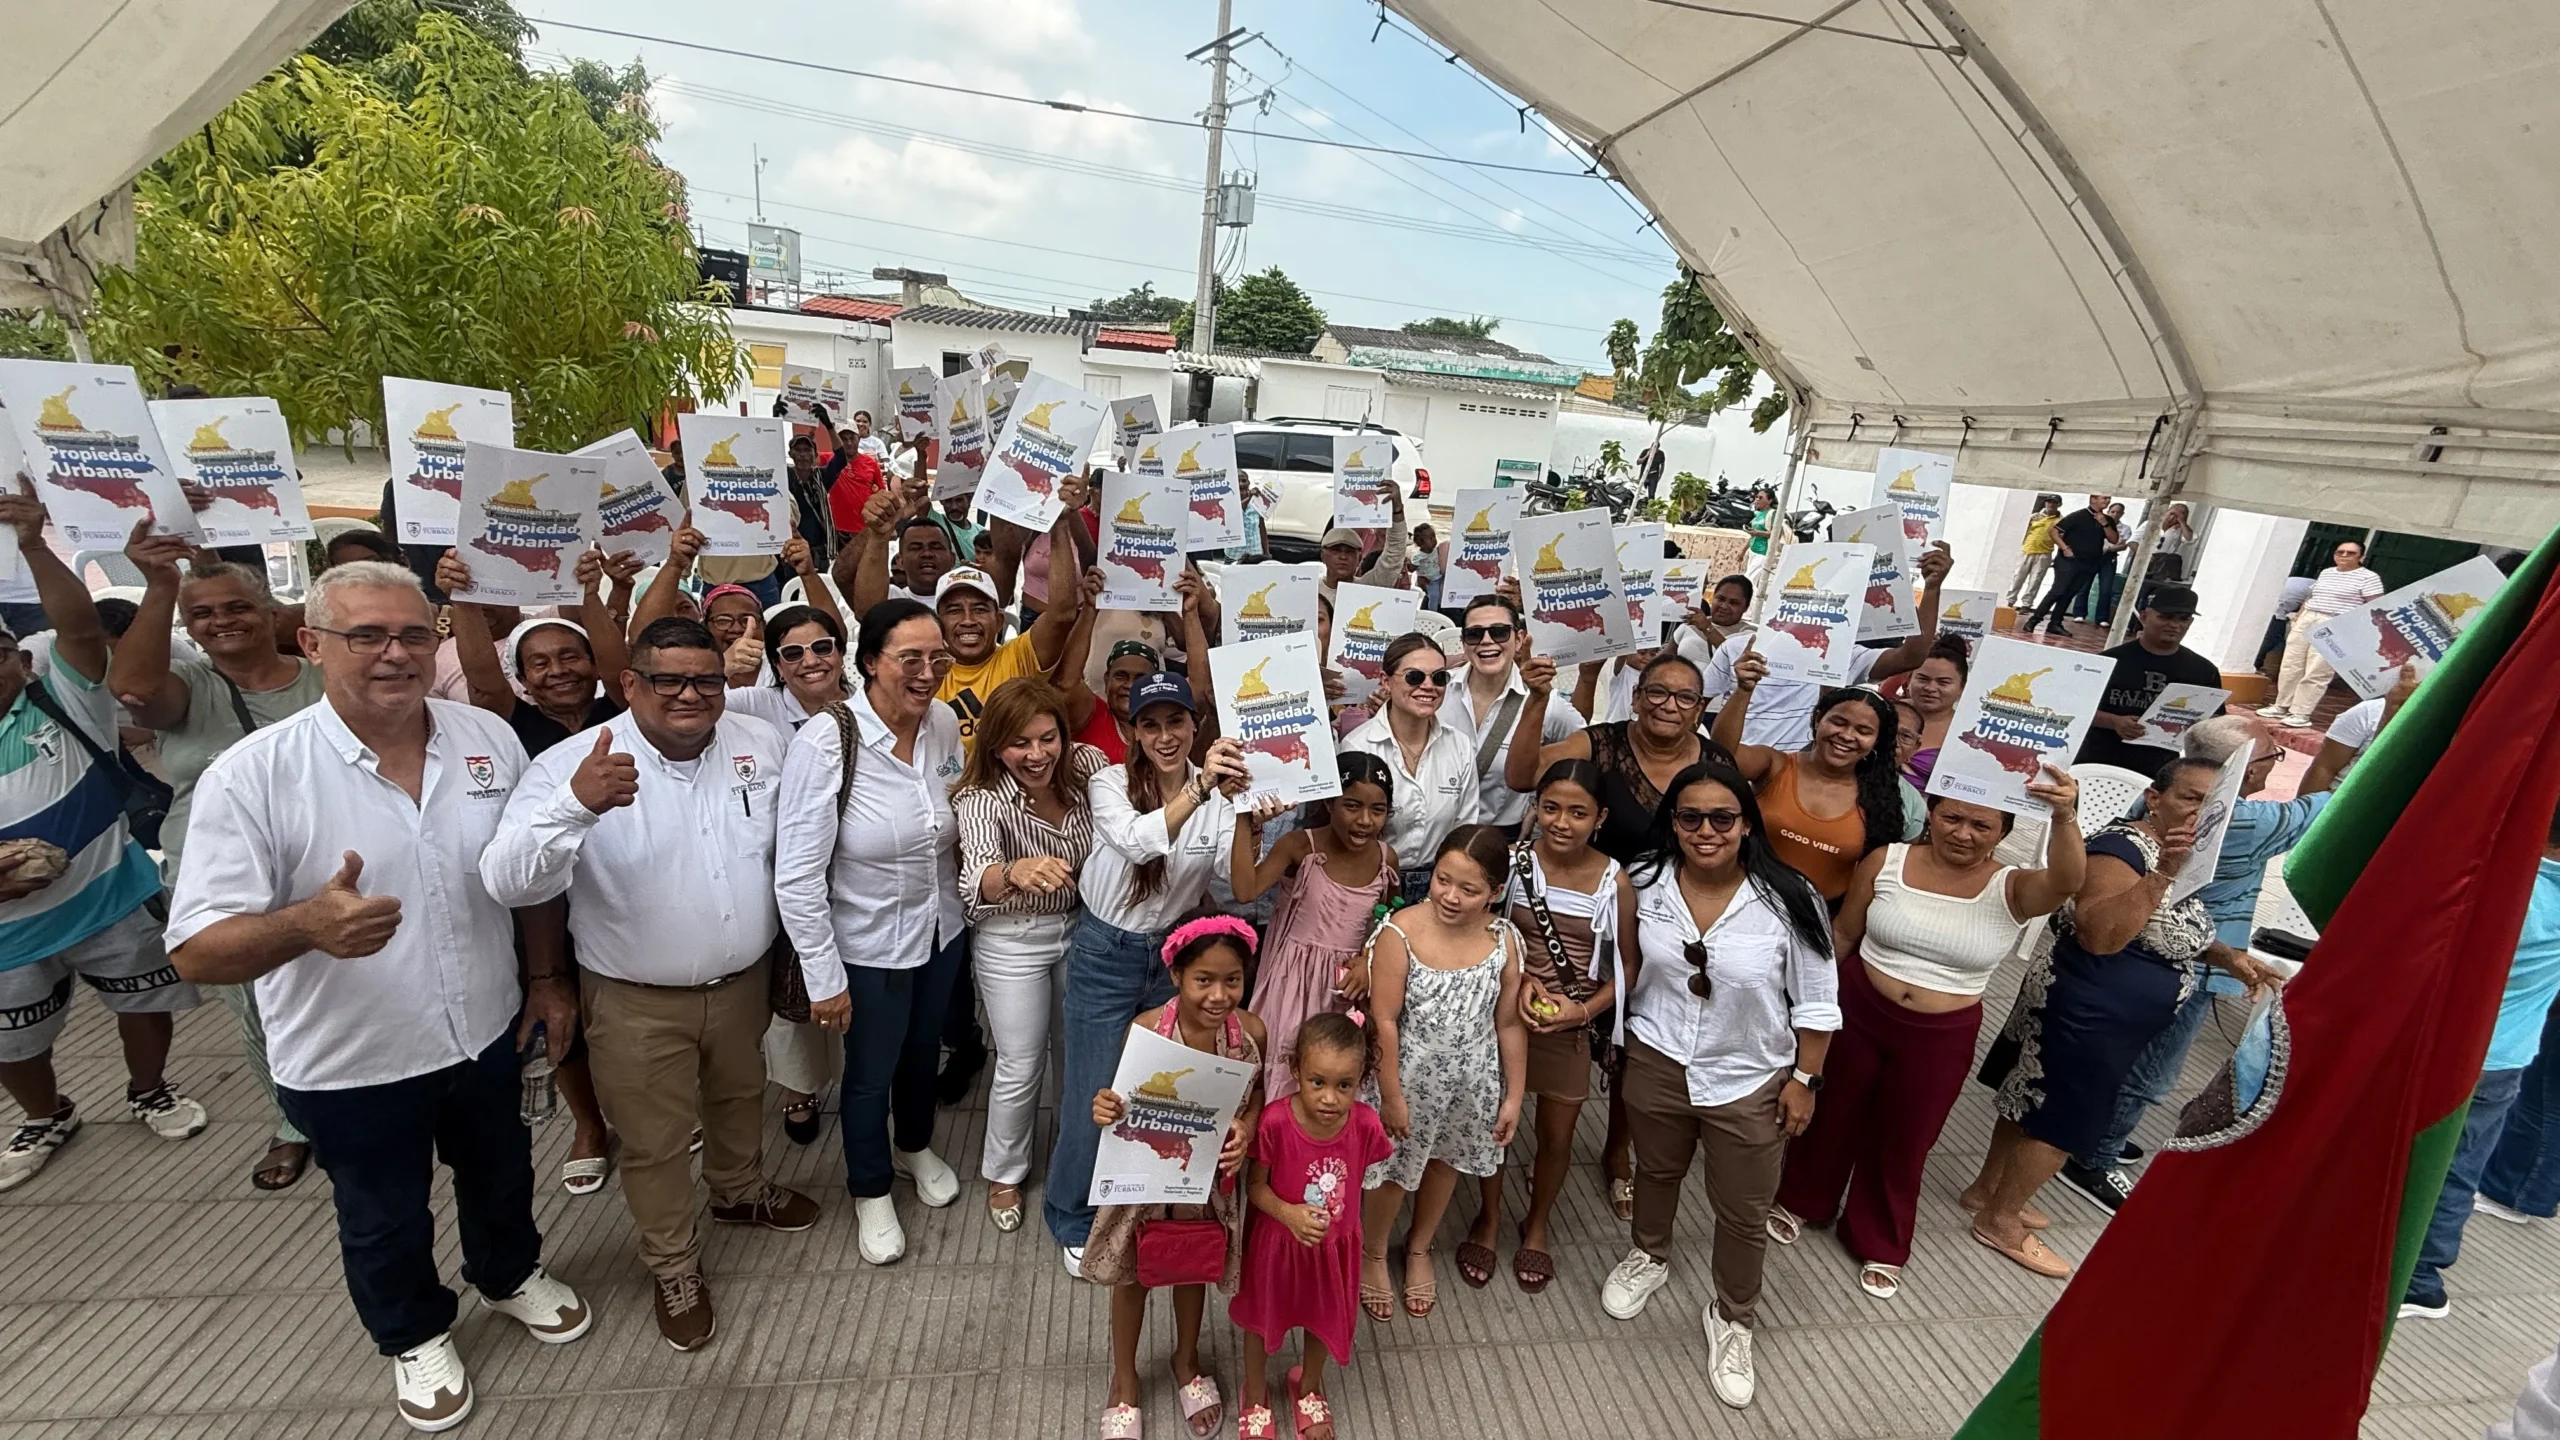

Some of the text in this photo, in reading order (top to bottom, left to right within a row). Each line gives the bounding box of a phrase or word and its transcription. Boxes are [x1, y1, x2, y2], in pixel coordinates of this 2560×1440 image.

[47, 445, 145, 463] Propiedad
[951, 440, 982, 454] Urbana
[1013, 433, 1071, 467] Propiedad
[416, 452, 465, 467] Propi
[1009, 445, 1057, 473] Urbana
[54, 462, 135, 478] Urbana
[197, 462, 278, 475] Propiedad
[418, 465, 464, 480] Urba
[201, 475, 267, 488] Urbana
[707, 478, 775, 490] Propiedad
[1344, 482, 1377, 491] Urbana
[708, 490, 764, 501] Urbana
[598, 491, 659, 518] Propiedad
[605, 502, 655, 528] Urbana
[487, 518, 577, 535] Propiedad
[485, 532, 560, 548] Urbana
[1114, 533, 1174, 547] Propiedad
[1463, 541, 1508, 551] Propiedad
[1114, 545, 1163, 558] Urbana
[1462, 551, 1500, 561] Urbana
[1536, 582, 1605, 599] Propiedad
[1538, 596, 1595, 612] Urbana
[1779, 599, 1846, 616] Propiedad
[1776, 610, 1830, 627] Urbana
[2385, 611, 2430, 657] Urbana
[2406, 600, 2448, 655] Propieda
[1345, 637, 1387, 651] Propied
[1239, 700, 1289, 713] Formalización
[1981, 696, 2044, 714] Saneamiento
[1238, 705, 1311, 726] Propiedad
[1241, 722, 1301, 742] Urbana
[1979, 711, 2068, 740] Propiedad
[1974, 724, 2046, 750] Urbana
[1780, 828, 1840, 854] GOOD VIBES
[1130, 1103, 1214, 1126] Propiedad
[1127, 1114, 1196, 1135] Urbana
